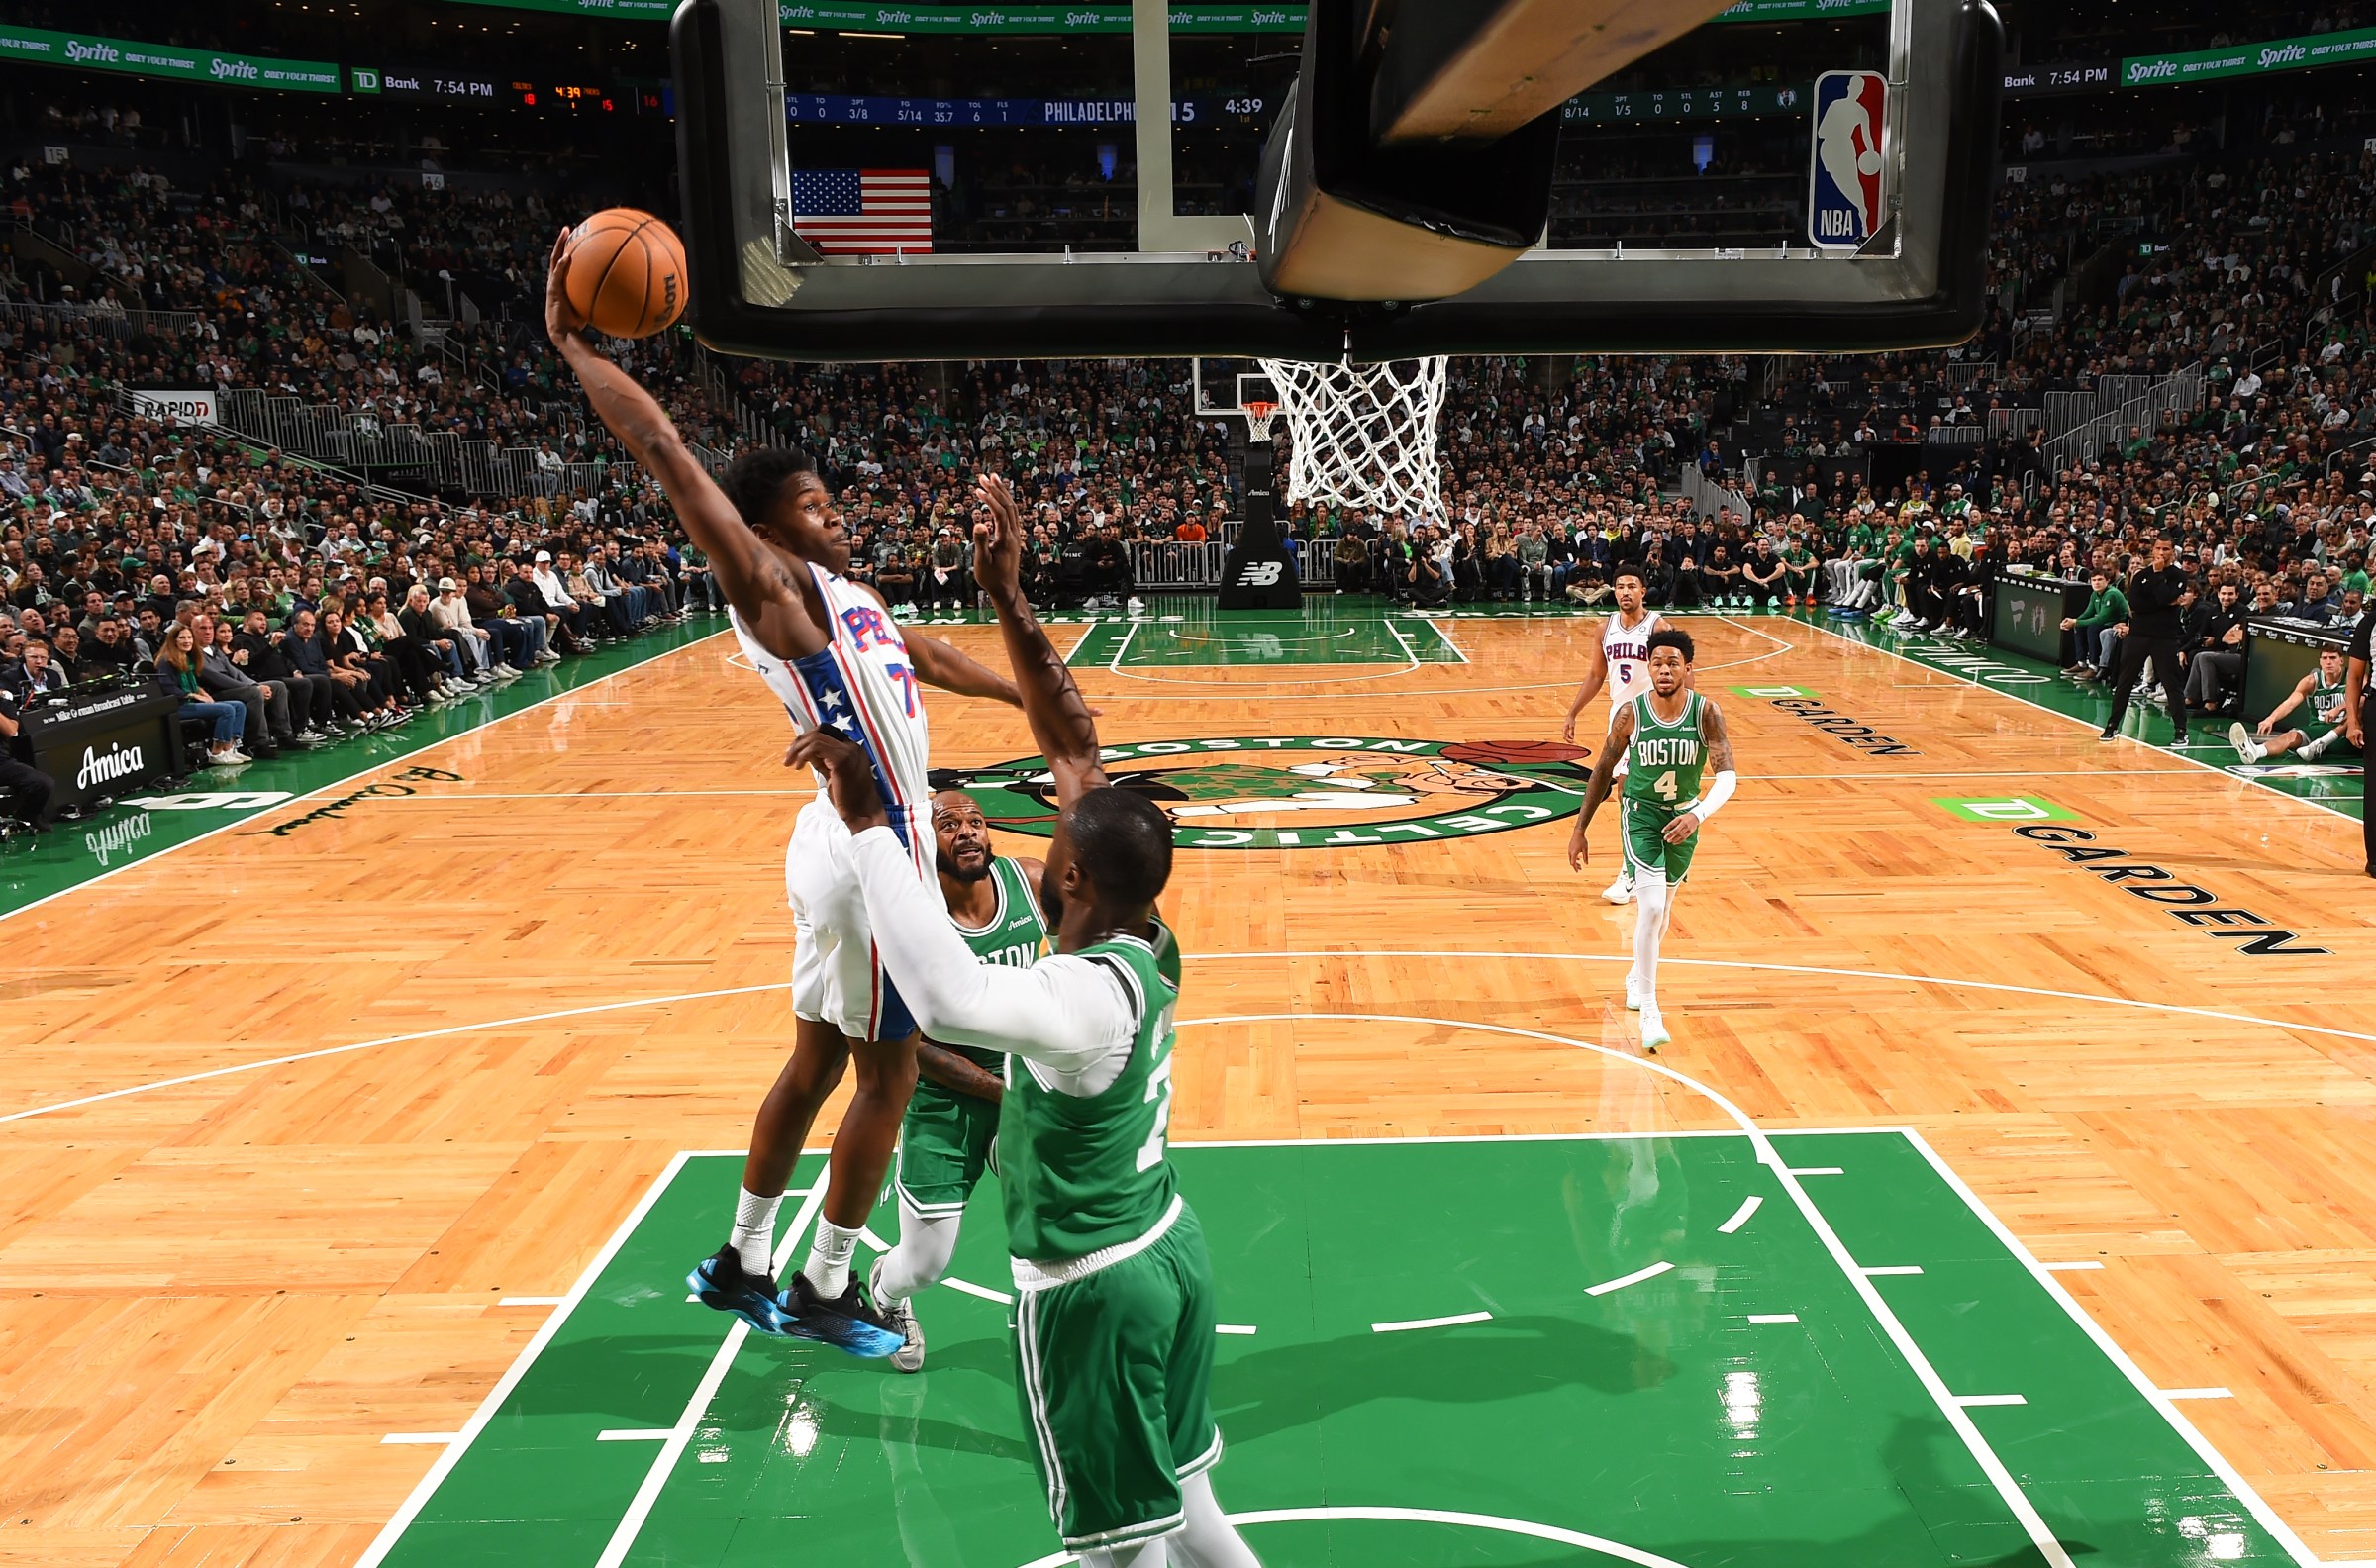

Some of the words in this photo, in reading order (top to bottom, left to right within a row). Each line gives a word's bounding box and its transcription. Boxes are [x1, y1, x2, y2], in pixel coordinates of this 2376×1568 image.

[779, 5, 814, 20] Sprite
[876, 10, 911, 24] Sprite
[1168, 12, 1193, 24] prite
[1251, 11, 1285, 25] Sprite
[1721, 1, 1753, 16] prite
[970, 12, 1005, 27] Sprite
[1065, 12, 1100, 27] Sprite
[65, 40, 119, 63] Sprite
[2257, 44, 2306, 68] Sprite
[210, 58, 259, 79] Sprite
[2004, 74, 2035, 87] Bank
[2050, 70, 2080, 85] 7:54
[2085, 68, 2107, 82] PM
[2127, 60, 2177, 82] Sprite
[353, 71, 377, 88] TD
[385, 76, 420, 90] Bank
[434, 79, 465, 94] 7:54
[469, 82, 493, 97] PM
[555, 86, 581, 98] 4:39
[524, 93, 536, 105] 18
[602, 99, 613, 111] 15
[1225, 98, 1263, 113] 4:39
[790, 106, 798, 117] 0
[818, 107, 826, 118] 0
[849, 108, 868, 119] 3/8
[898, 110, 922, 121] 5/14
[934, 111, 953, 122] 35.7
[973, 111, 980, 121] 6
[1002, 111, 1007, 121] 1
[1045, 102, 1136, 121] PHILADELPHI
[1564, 107, 1589, 118] 8/14
[1616, 105, 1631, 116] 1/5
[1654, 104, 1662, 114] 0
[1683, 103, 1691, 113] 0
[1713, 101, 1720, 112] 5
[1740, 100, 1748, 110] 8
[1820, 209, 1854, 236] NBA
[1247, 488, 1270, 497] Amica
[1606, 642, 1648, 662] PHILA
[1620, 664, 1632, 685] 5
[1769, 698, 1925, 756] GARDEN
[1637, 738, 1700, 767] BOSTON
[77, 741, 144, 790] Amica
[1653, 770, 1678, 802] 4
[1171, 805, 1553, 845] CELTIC
[2012, 824, 2335, 957] GARDEN
[1008, 915, 1033, 931] Amica
